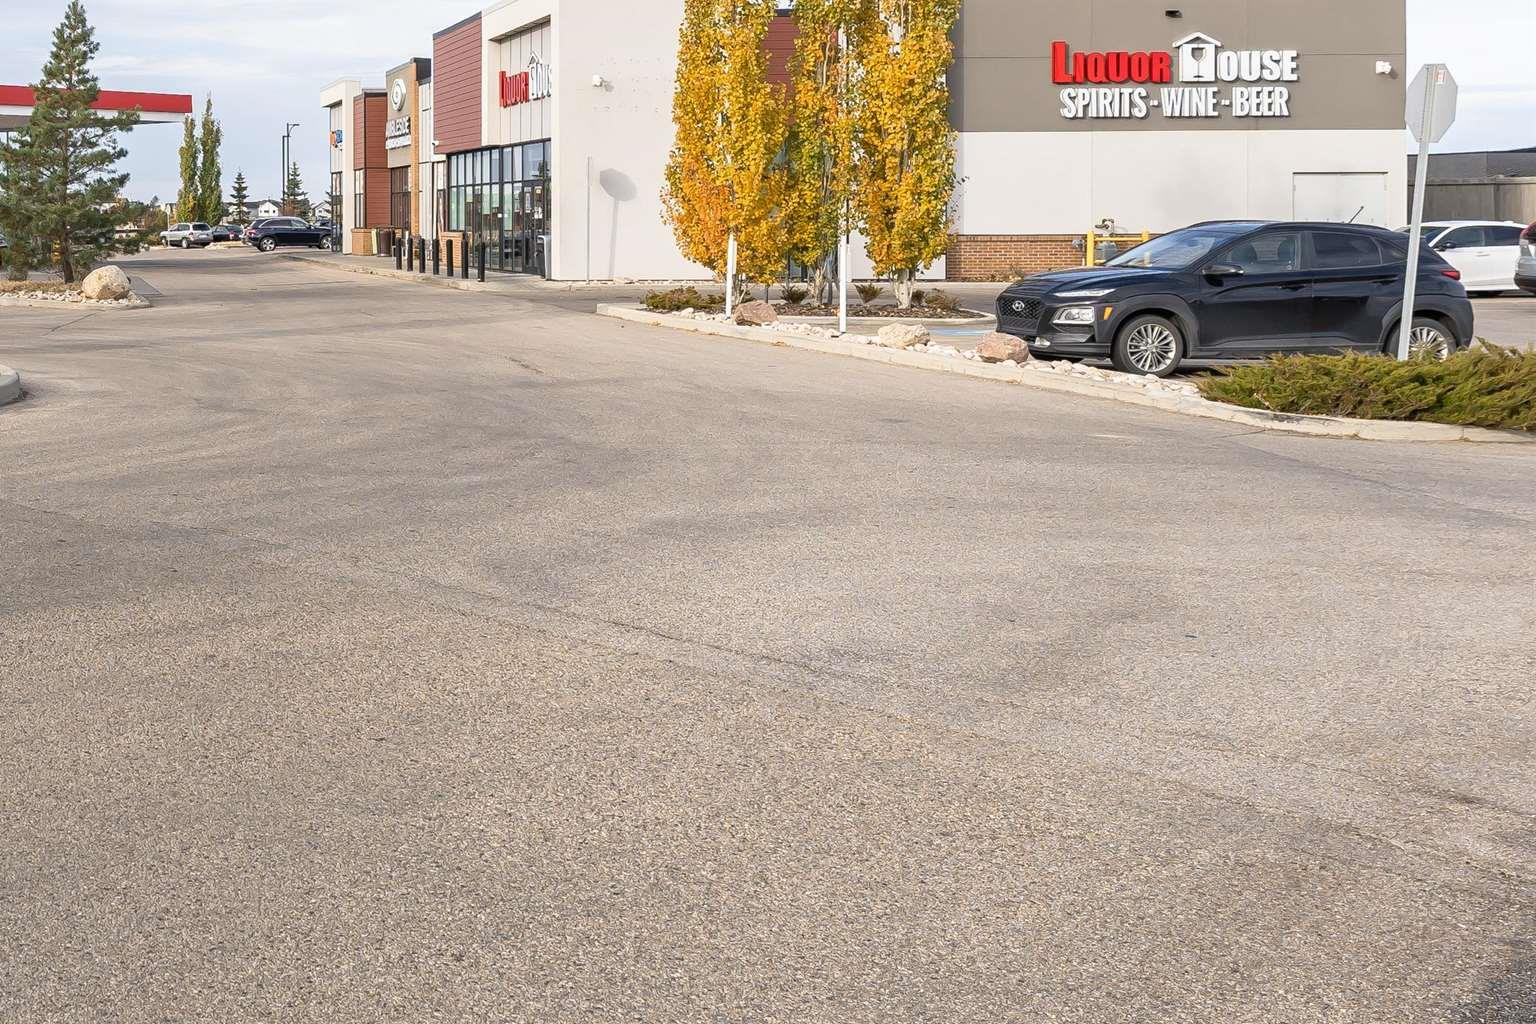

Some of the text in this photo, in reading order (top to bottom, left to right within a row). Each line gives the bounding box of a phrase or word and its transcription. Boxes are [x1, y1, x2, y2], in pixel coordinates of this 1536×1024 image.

[1050, 40, 1174, 85] LIQUOR
[1059, 86, 1290, 119] SPIRITS WINE BEER
